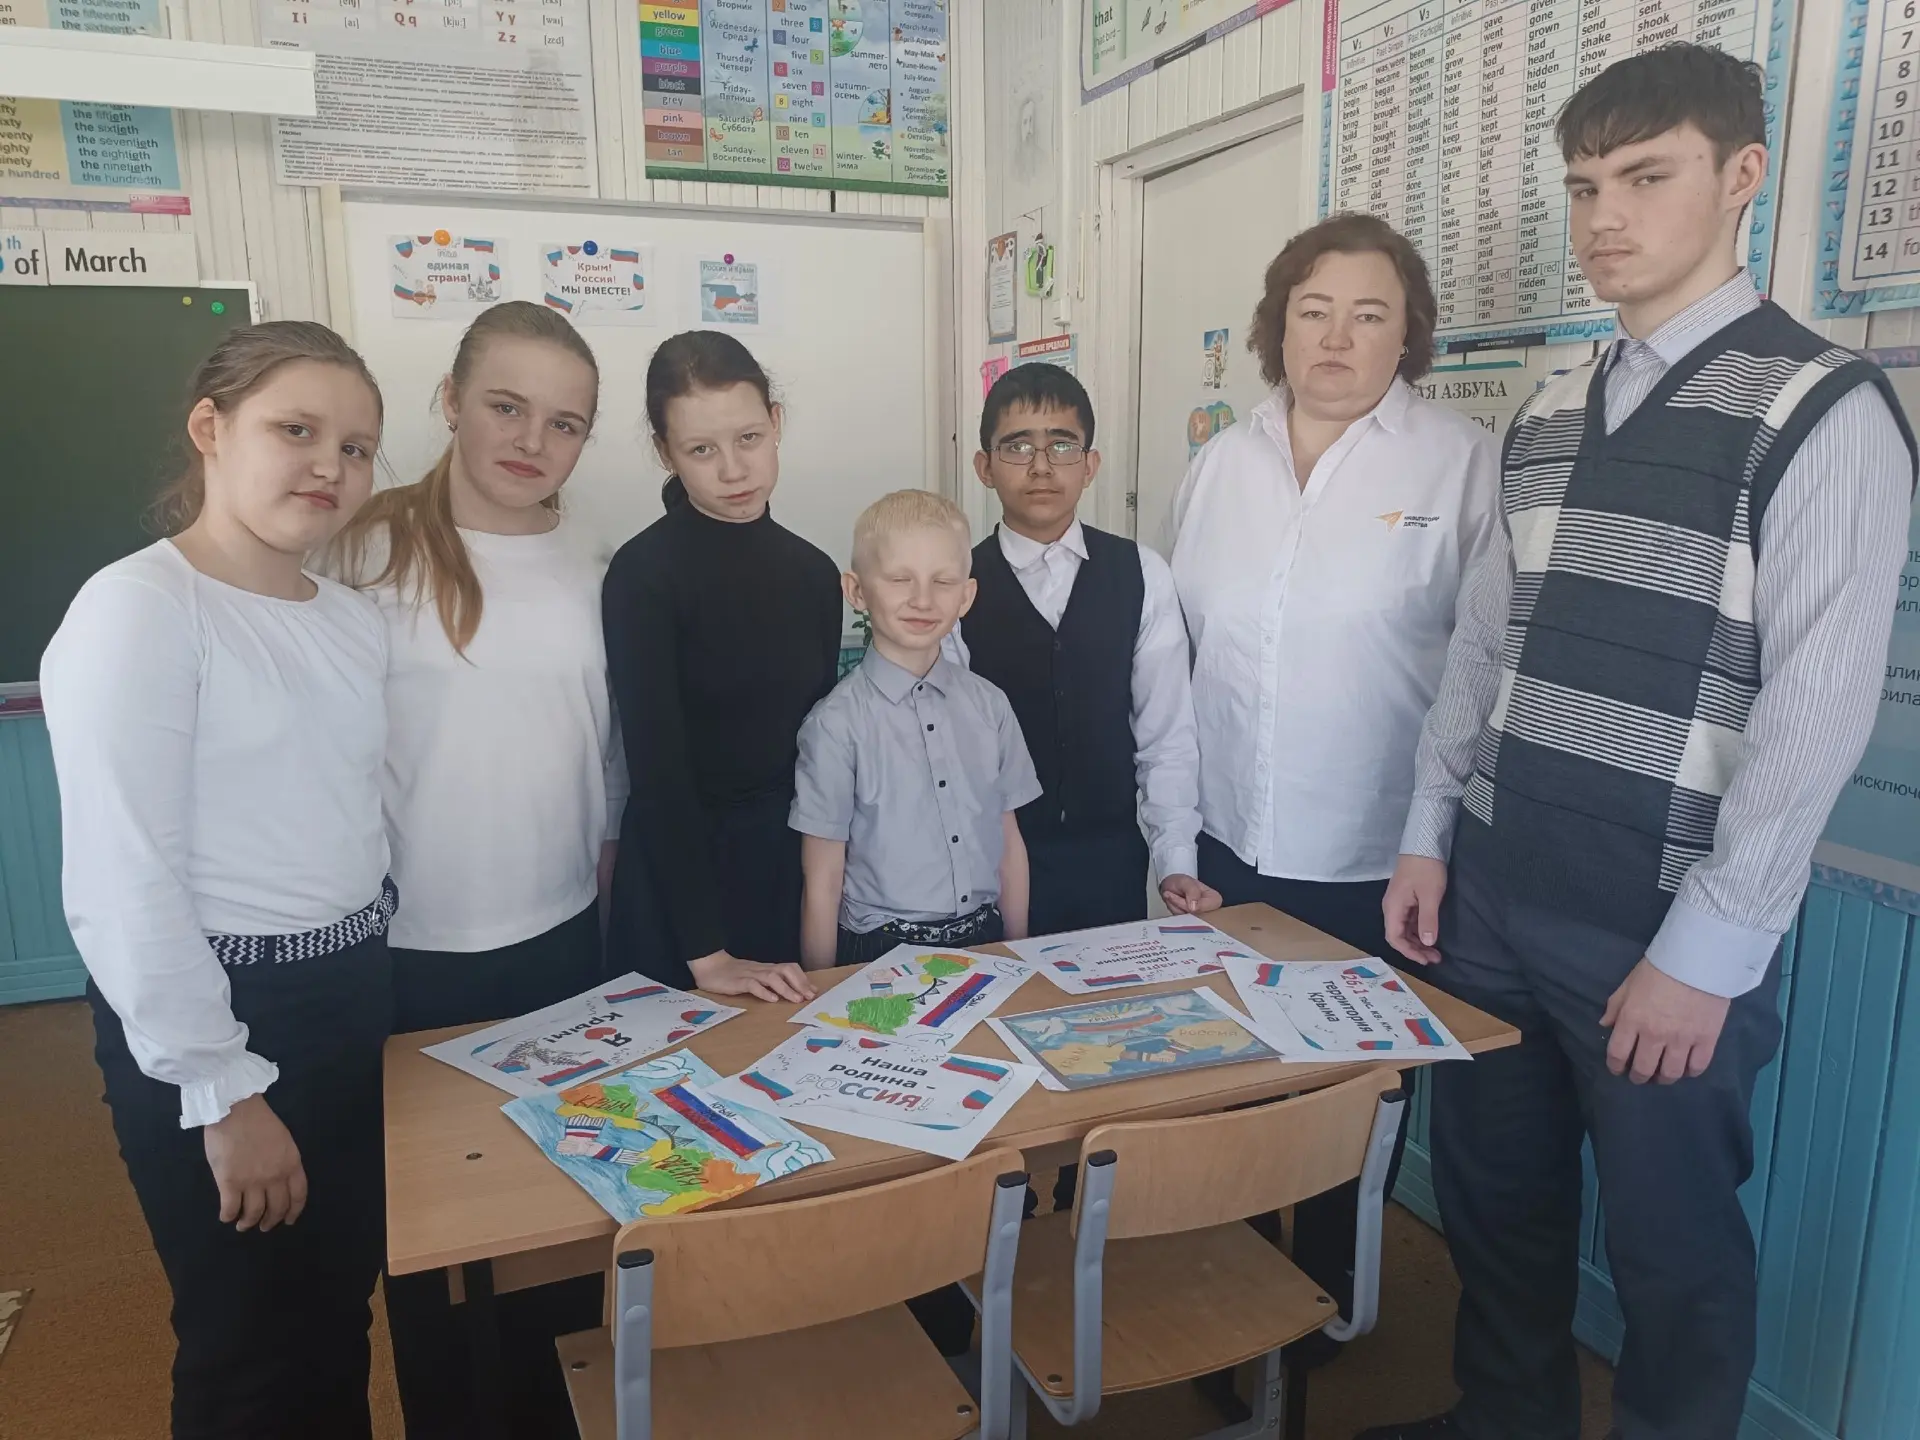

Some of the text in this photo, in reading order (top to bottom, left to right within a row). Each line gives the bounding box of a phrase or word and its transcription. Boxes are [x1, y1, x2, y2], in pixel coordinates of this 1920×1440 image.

[60, 7, 79, 17] the
[789, 2, 807, 12] two
[1582, 6, 1600, 21] sell
[1638, 1, 1662, 17] sent
[1904, 1, 1915, 19] 6
[653, 9, 685, 20] yellow
[1094, 6, 1113, 27] that
[1529, 10, 1554, 28] gone
[1696, 6, 1735, 28] shown
[62, 20, 81, 30] the
[780, 18, 804, 28] three
[1484, 15, 1503, 31] gave
[1581, 18, 1606, 35] send
[1637, 12, 1670, 32] shook
[655, 26, 684, 37] green
[722, 32, 748, 42] Среда
[1483, 27, 1504, 42] went
[1528, 22, 1560, 41] grown
[1636, 23, 1678, 47] showed
[1695, 25, 1721, 43] shut
[791, 35, 809, 45] four
[1445, 32, 1462, 46] give
[1528, 38, 1546, 53] had
[1580, 32, 1611, 50] shake
[1901, 30, 1914, 49] 7
[660, 45, 682, 55] blue
[791, 51, 807, 60] five
[1409, 48, 1426, 60] been
[1483, 42, 1503, 58] grew
[1580, 47, 1607, 64] show
[1444, 57, 1464, 72] grow
[1527, 49, 1556, 67] heard
[655, 62, 688, 74] purple
[792, 67, 803, 75] six
[868, 62, 888, 70] лето
[1526, 62, 1560, 80] hidden
[1578, 62, 1601, 78] shut
[1897, 60, 1911, 79] 8
[1409, 71, 1430, 84] begun
[1444, 70, 1462, 83] have
[1482, 65, 1505, 81] heard
[658, 78, 685, 90] black
[782, 82, 807, 91] seven
[1375, 84, 1395, 97] began
[1408, 82, 1431, 96] broken
[1443, 83, 1461, 95] hear
[1526, 78, 1547, 93] held
[662, 96, 683, 106] grey
[719, 92, 756, 103] Пятница
[835, 92, 860, 100] осень
[1525, 93, 1546, 107] hurt
[1895, 90, 1907, 108] 9
[792, 99, 814, 108] eight
[73, 109, 132, 123] the fiftieth
[662, 113, 684, 123] pink
[789, 114, 808, 123] nine
[1525, 106, 1546, 120] kept
[74, 121, 139, 135] the sixtieth
[721, 123, 756, 133] Суббота
[1480, 120, 1498, 133] kept
[1878, 120, 1904, 140] 10
[657, 129, 690, 141] brown
[794, 130, 809, 138] ten
[1407, 130, 1430, 144] caught
[1480, 133, 1501, 146] knew
[77, 134, 158, 149] the seventieth
[1371, 141, 1396, 155] caught
[79, 147, 151, 161] the eightieth
[667, 148, 683, 156] tan
[780, 145, 809, 155] eleven
[1407, 143, 1430, 156] chosen
[80, 159, 152, 173] the ninetieth
[836, 162, 859, 170] зима
[1875, 150, 1900, 169] 11
[794, 162, 823, 171] twelve
[8, 169, 60, 180] hundred
[82, 172, 162, 185] the hundredth
[1871, 178, 1897, 198] 12
[1405, 191, 1426, 203] drawn
[1370, 201, 1388, 211] drew
[1405, 203, 1424, 214] drunk
[1521, 199, 1546, 212] made
[1521, 211, 1549, 225] meant
[1867, 207, 1893, 226] 13
[1404, 227, 1423, 238] eaten
[1520, 238, 1539, 252] paid
[1862, 242, 1888, 261] 14
[1477, 248, 1493, 260] paid
[15, 248, 147, 275] of March
[427, 262, 470, 271] единая
[577, 262, 612, 272] Крым!
[1519, 266, 1538, 276] read
[427, 273, 471, 284] страна!
[574, 274, 616, 283] Россия!
[1518, 278, 1546, 289] ridden
[561, 285, 631, 296] МЫ ВМЕСТЕ!
[1518, 291, 1538, 302] rung
[1566, 285, 1584, 296] win
[1478, 298, 1495, 308] rang
[1566, 298, 1591, 309] write
[1441, 380, 1507, 399] АЗБУКА
[1853, 773, 1920, 799] исключ
[1307, 992, 1340, 1022] Крыма
[1323, 981, 1374, 1033] территория
[543, 1012, 624, 1043] Крым!
[601, 1032, 632, 1047] Я
[861, 1056, 929, 1077] Наша
[796, 1074, 935, 1110] РОССИЯ!
